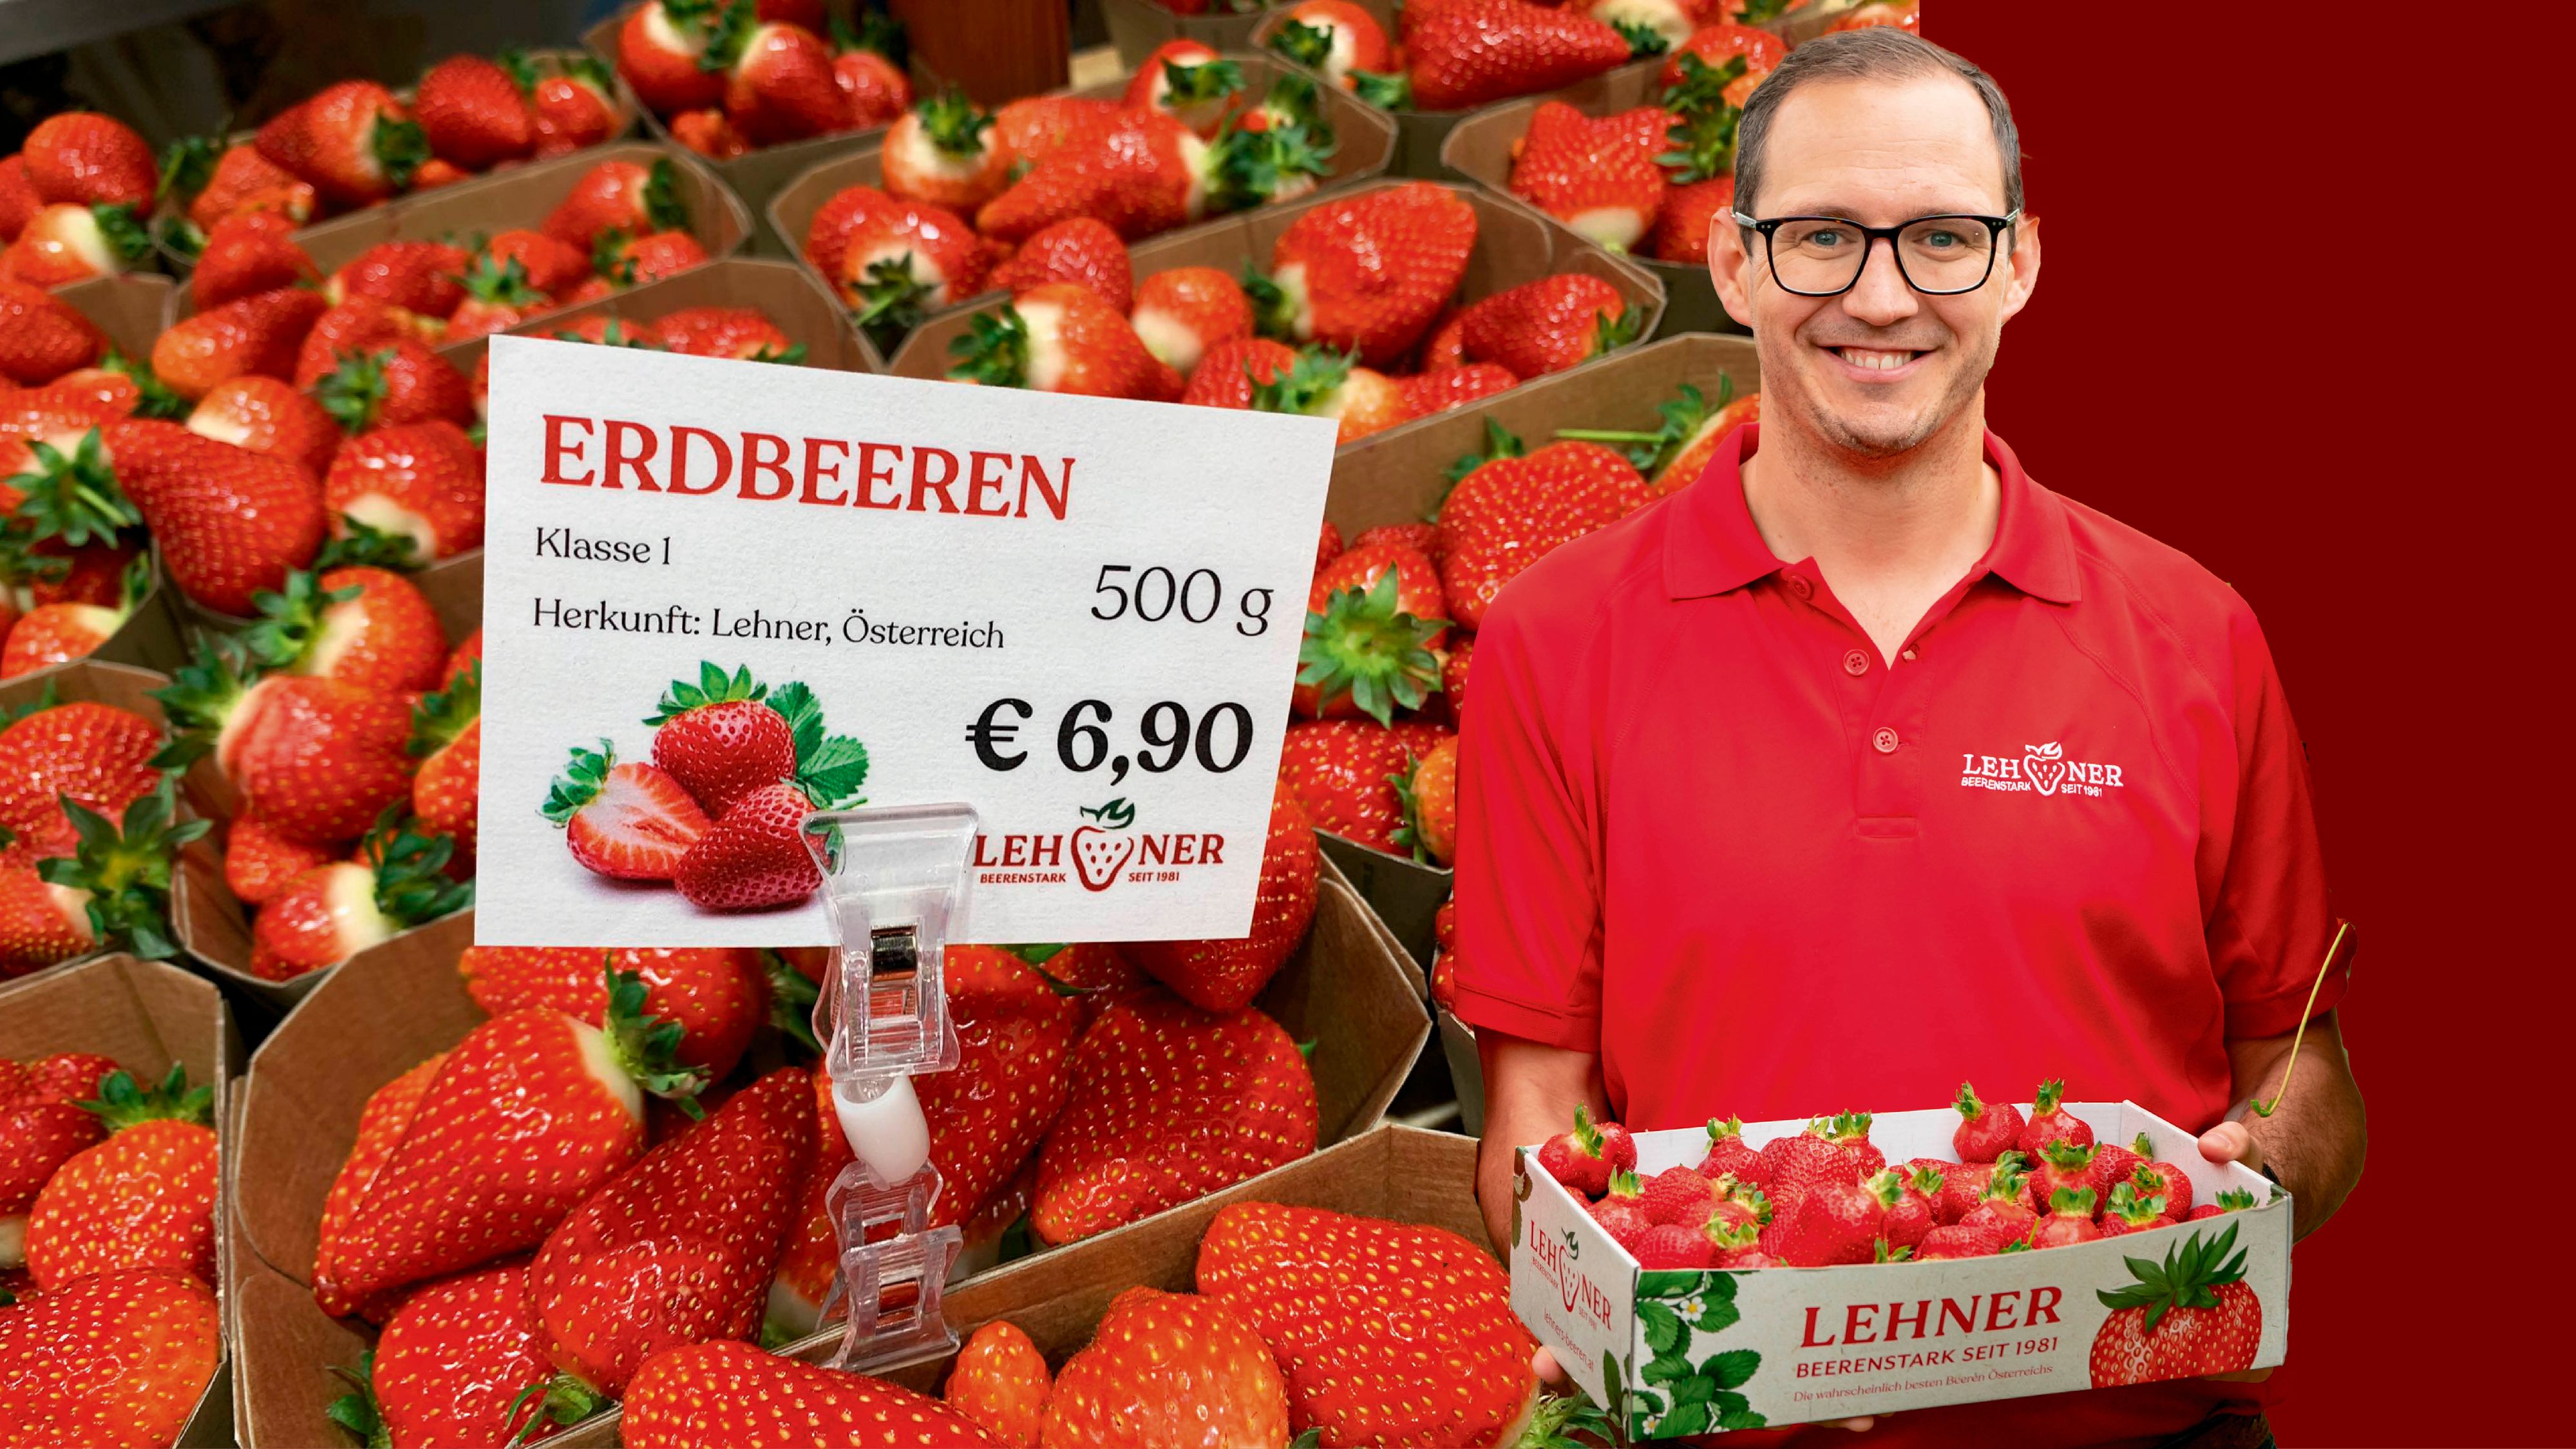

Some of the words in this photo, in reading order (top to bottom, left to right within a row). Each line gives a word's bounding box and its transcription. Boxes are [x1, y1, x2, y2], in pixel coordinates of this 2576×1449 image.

[540, 414, 1076, 520] ERDBEEREN
[535, 527, 651, 564] Klasse
[662, 537, 671, 565] 1
[533, 598, 701, 636] Herkunft:
[712, 609, 833, 644] Lehner,
[842, 609, 1005, 649] Österreich
[1091, 565, 1222, 623] 500
[1236, 588, 1274, 636] g
[965, 698, 1033, 772] €
[1057, 699, 1253, 786] 6,90
[1961, 777, 2031, 791] BEERENSTARK
[2061, 784, 2082, 795] SEIT
[980, 873, 1066, 884] BEERENSTARK
[1128, 873, 1155, 882] SEIT
[1157, 872, 1180, 882] 1981
[1532, 1256, 1558, 1289] BEERENSTARK
[1544, 1308, 1594, 1372] lehners-beeren.at
[1800, 1286, 2063, 1348] LEHNER
[1796, 1349, 1956, 1378] BEERENSTARK
[1962, 1343, 2010, 1362] SEIT
[2016, 1336, 2058, 1356] 1981
[1794, 1391, 1814, 1402] Die
[1815, 1381, 1902, 1400] wahrscheinlich
[1904, 1378, 1943, 1390] besten
[1987, 1364, 2054, 1381] Österreichs
